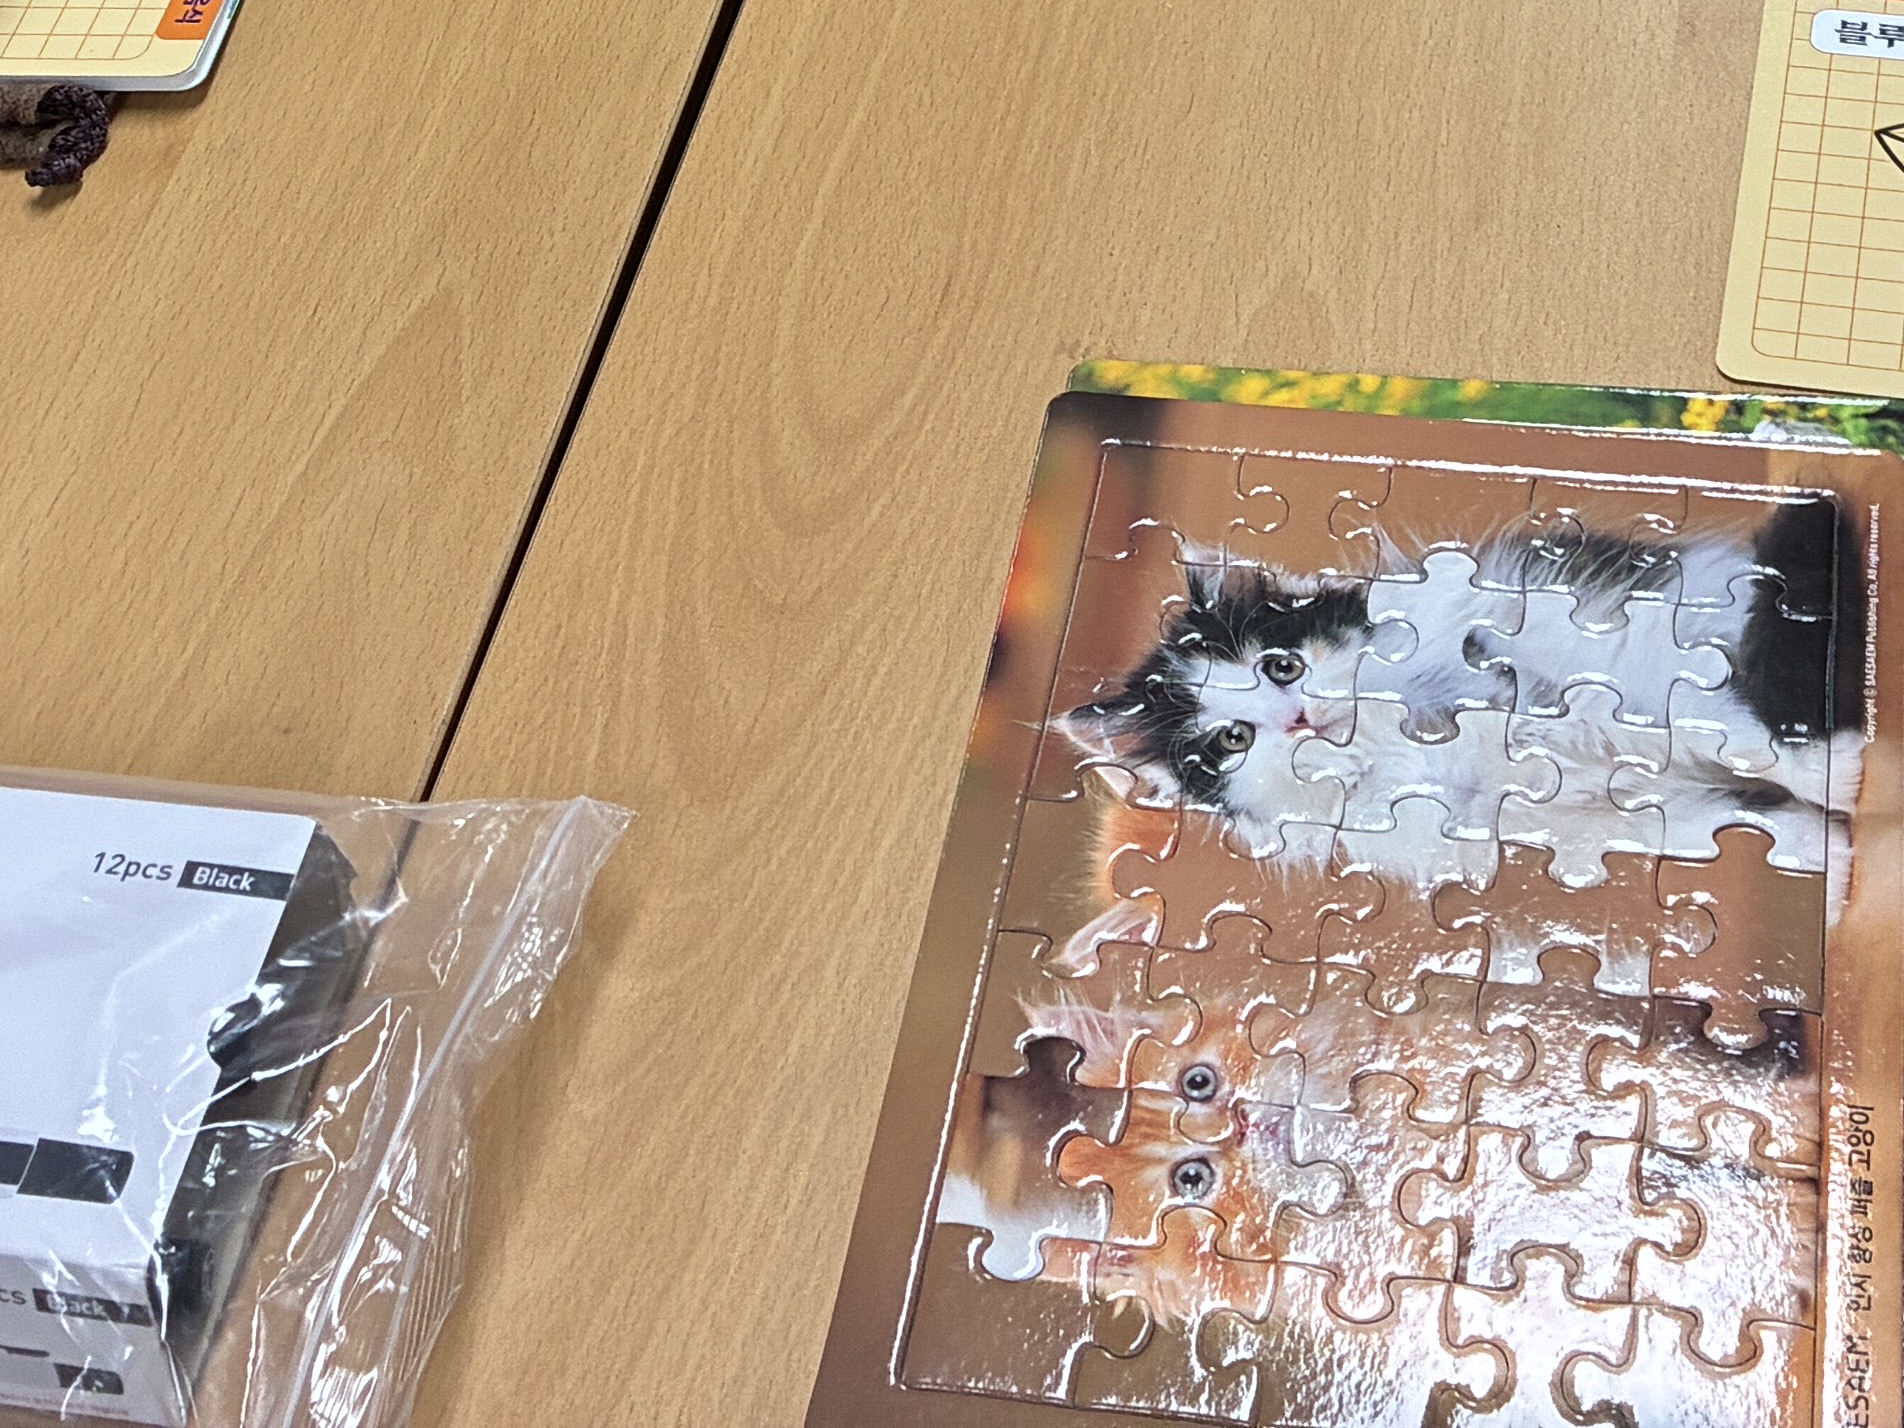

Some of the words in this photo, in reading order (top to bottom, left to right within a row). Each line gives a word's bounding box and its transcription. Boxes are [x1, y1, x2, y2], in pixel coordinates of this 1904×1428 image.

[1864, 699, 1878, 744] Copyright
[92, 851, 174, 883] 12pcs
[192, 866, 256, 892] Black
[1846, 1104, 1875, 1171] 고양이
[1849, 1176, 1874, 1218] 퍼즐
